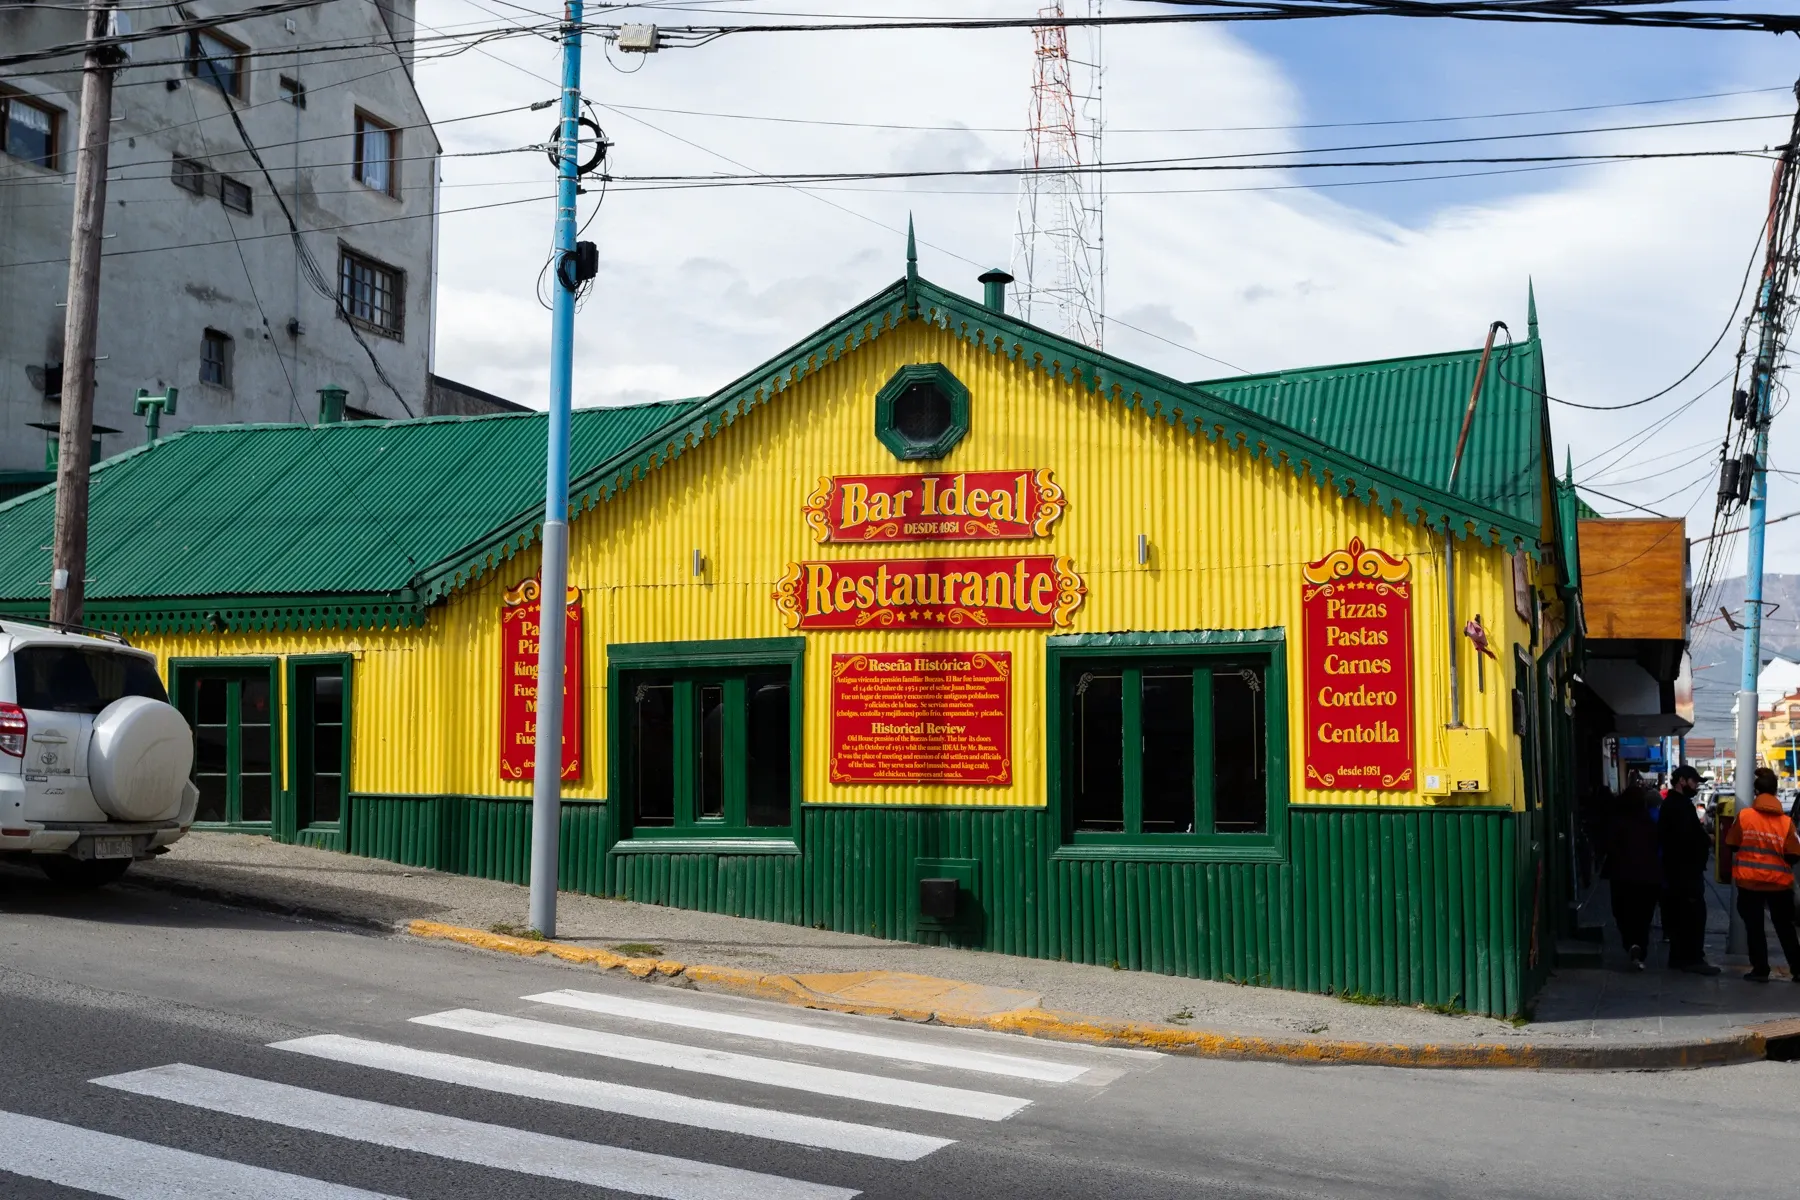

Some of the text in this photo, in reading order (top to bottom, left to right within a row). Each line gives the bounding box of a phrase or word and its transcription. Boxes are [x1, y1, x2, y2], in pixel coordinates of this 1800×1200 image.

[840, 473, 1030, 530] Bar Ideal
[903, 521, 960, 535] DESDE 1951
[805, 559, 1053, 617] Restaurante
[1326, 598, 1388, 620] Pizzas
[1326, 626, 1389, 647] Pastas
[868, 657, 971, 672] Reseña Histórica
[1323, 654, 1392, 675] Carnes
[972, 675, 1006, 684] inaugurado
[904, 685, 918, 693] 1951
[919, 685, 929, 693] por
[950, 684, 964, 693] Juan
[1317, 684, 1398, 707] Cordero
[860, 693, 874, 701] lugar
[944, 692, 968, 701] antiguos
[968, 692, 1000, 701] pobladores
[915, 710, 930, 718] pollo
[942, 709, 974, 718] empanadas
[871, 721, 966, 735] Historical Review
[1317, 721, 1400, 744] Centolla
[892, 745, 904, 753] 1951
[862, 753, 876, 761] place
[878, 761, 890, 770] They
[1337, 765, 1381, 777] desde 1951
